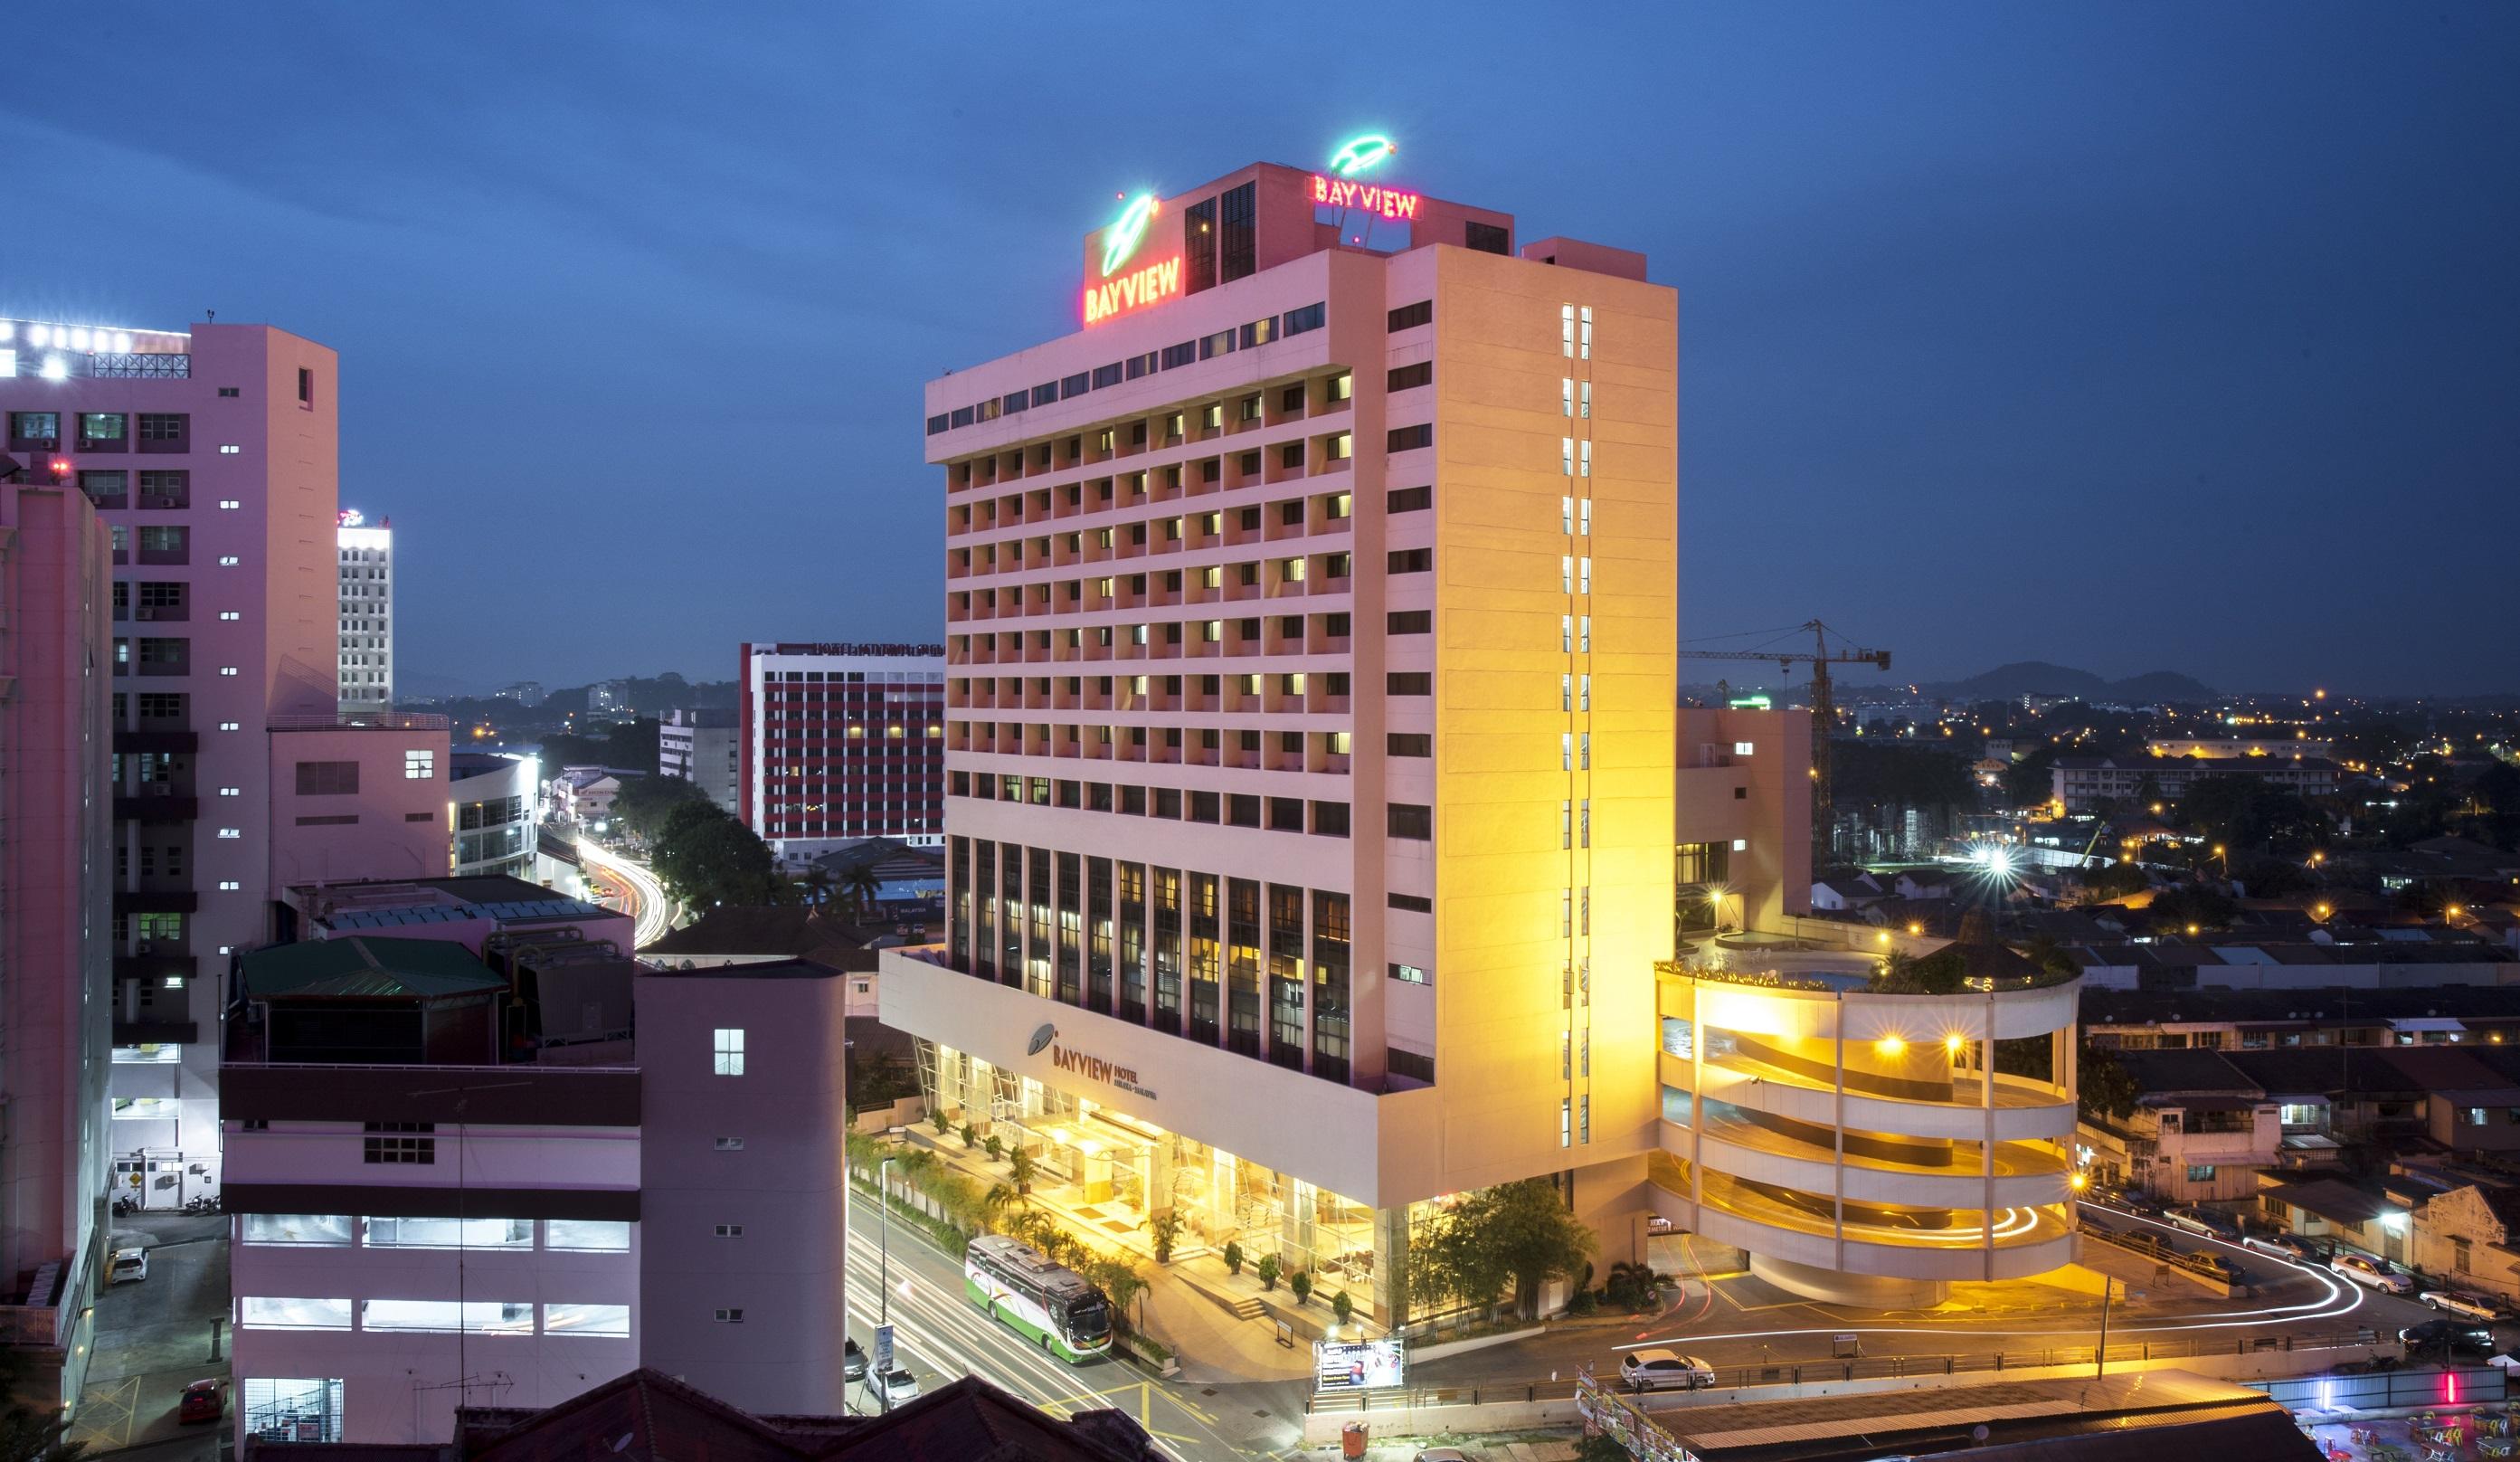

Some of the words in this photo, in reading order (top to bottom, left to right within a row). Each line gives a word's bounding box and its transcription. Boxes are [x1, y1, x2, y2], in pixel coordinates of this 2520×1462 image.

[1085, 256, 1180, 324] BAYVIEW
[1053, 1044, 1113, 1085] BAYVIEW
[1114, 1065, 1138, 1085] HOTEL
